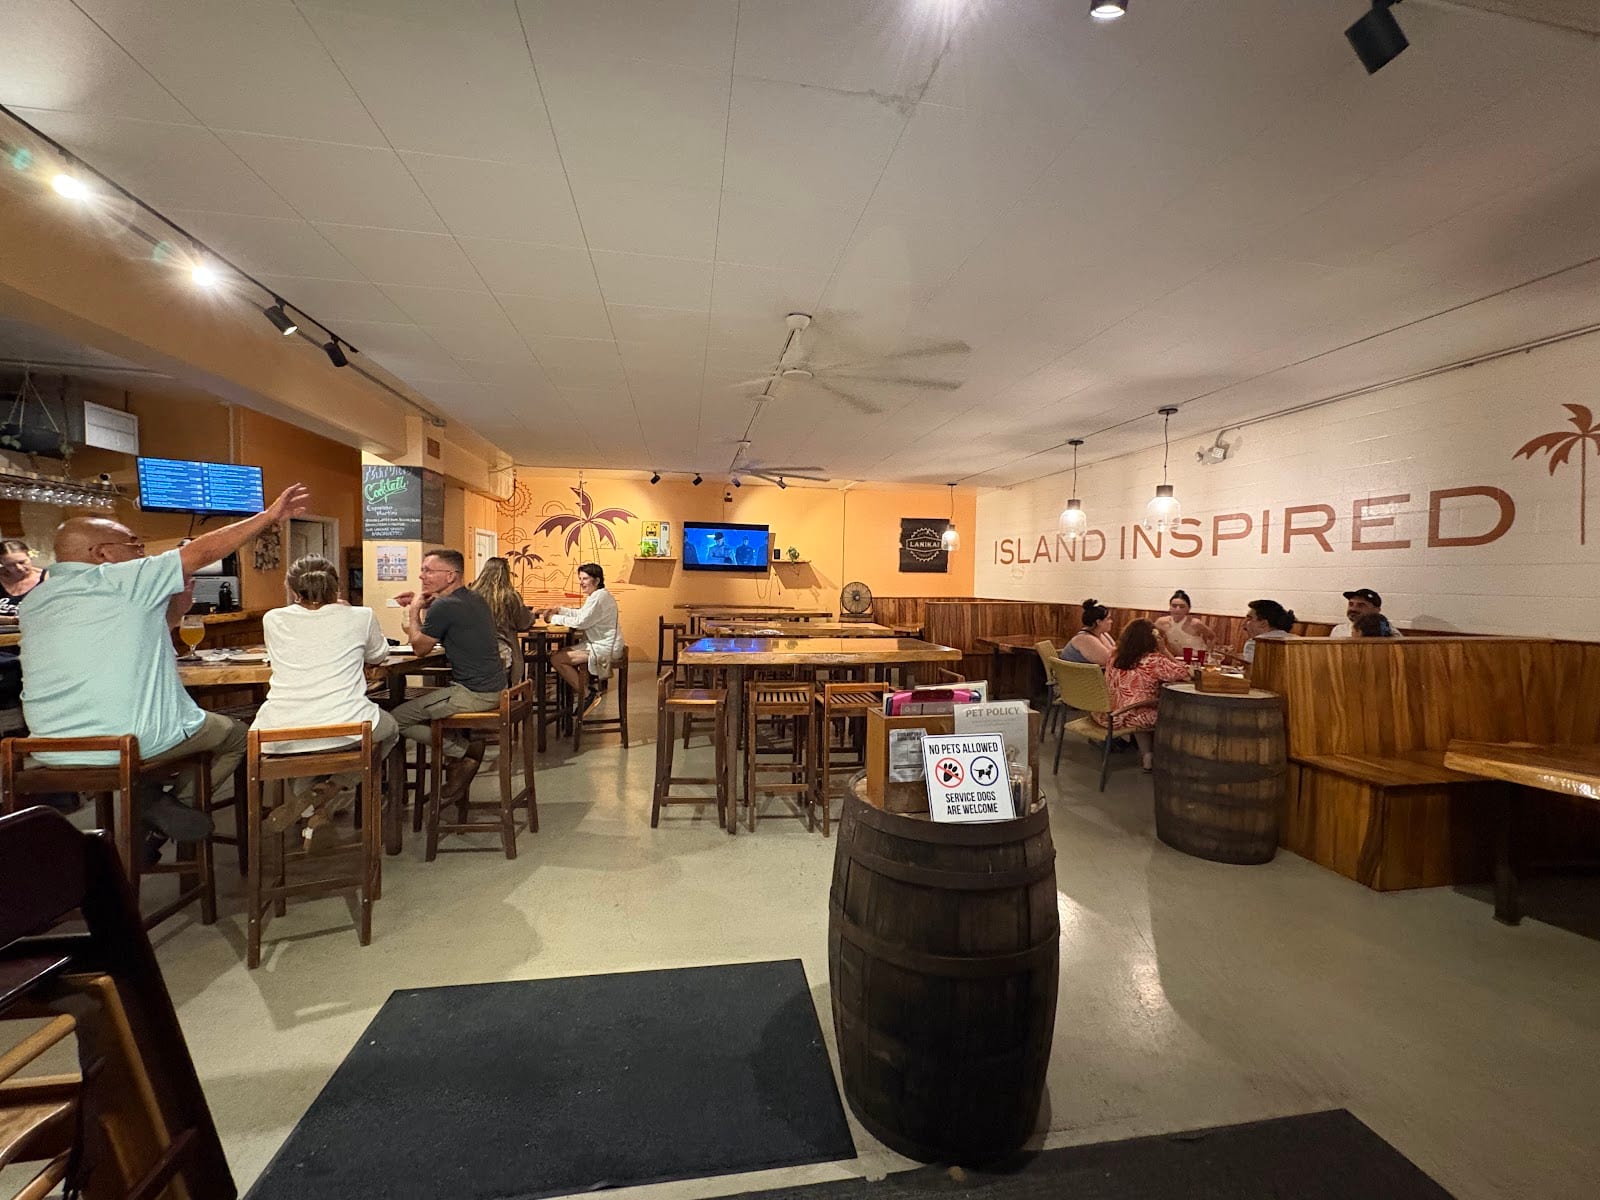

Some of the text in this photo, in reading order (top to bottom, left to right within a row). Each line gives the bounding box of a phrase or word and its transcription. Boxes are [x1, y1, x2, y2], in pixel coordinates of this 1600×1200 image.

[993, 485, 1517, 565] ISLAND INSPIRED
[965, 707, 1020, 718] PET POLICY
[928, 742, 999, 755] NO PETS ALLOWED
[945, 791, 996, 803] SERVICE DOGS
[947, 803, 999, 815] ARE WELCOME
